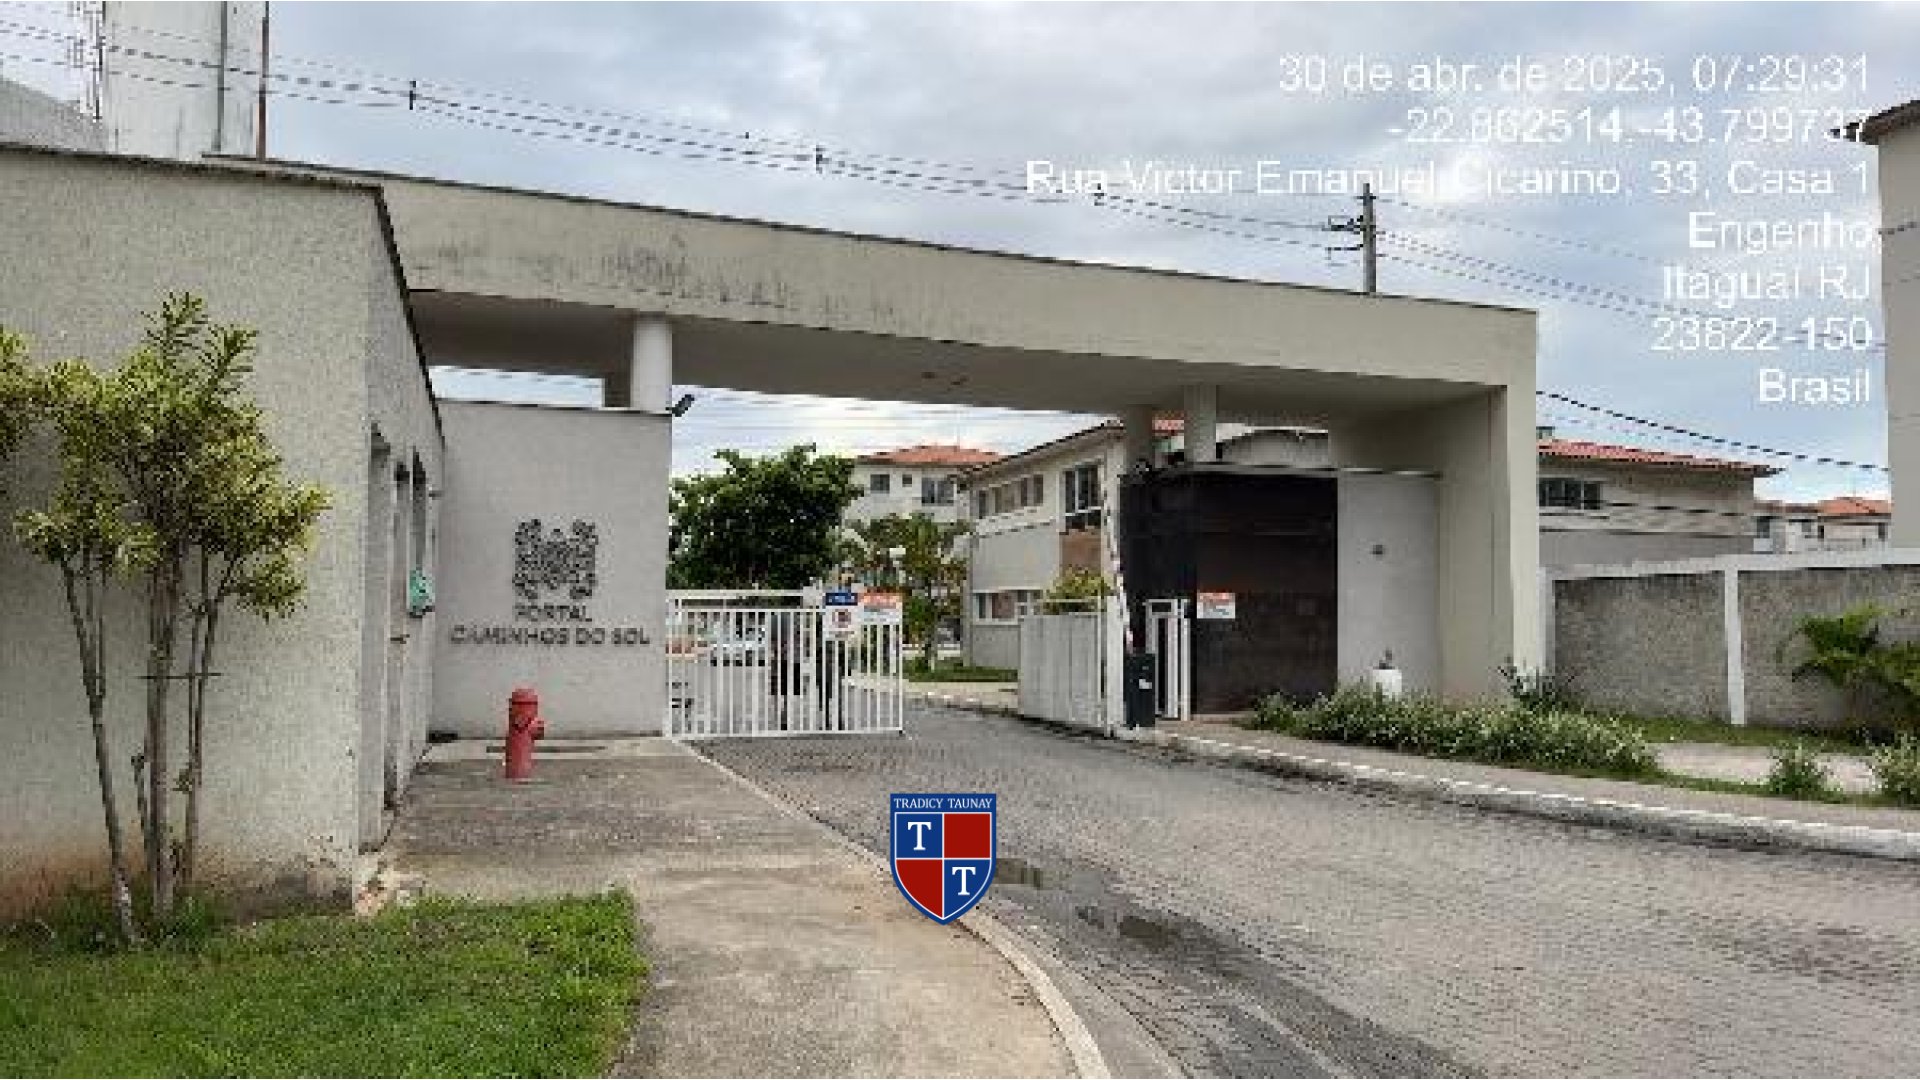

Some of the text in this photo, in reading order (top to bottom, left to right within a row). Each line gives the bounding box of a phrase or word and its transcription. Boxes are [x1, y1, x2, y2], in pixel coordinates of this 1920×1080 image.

[513, 604, 594, 622] PORTAL
[575, 626, 605, 645] DO
[612, 626, 650, 645] SOL
